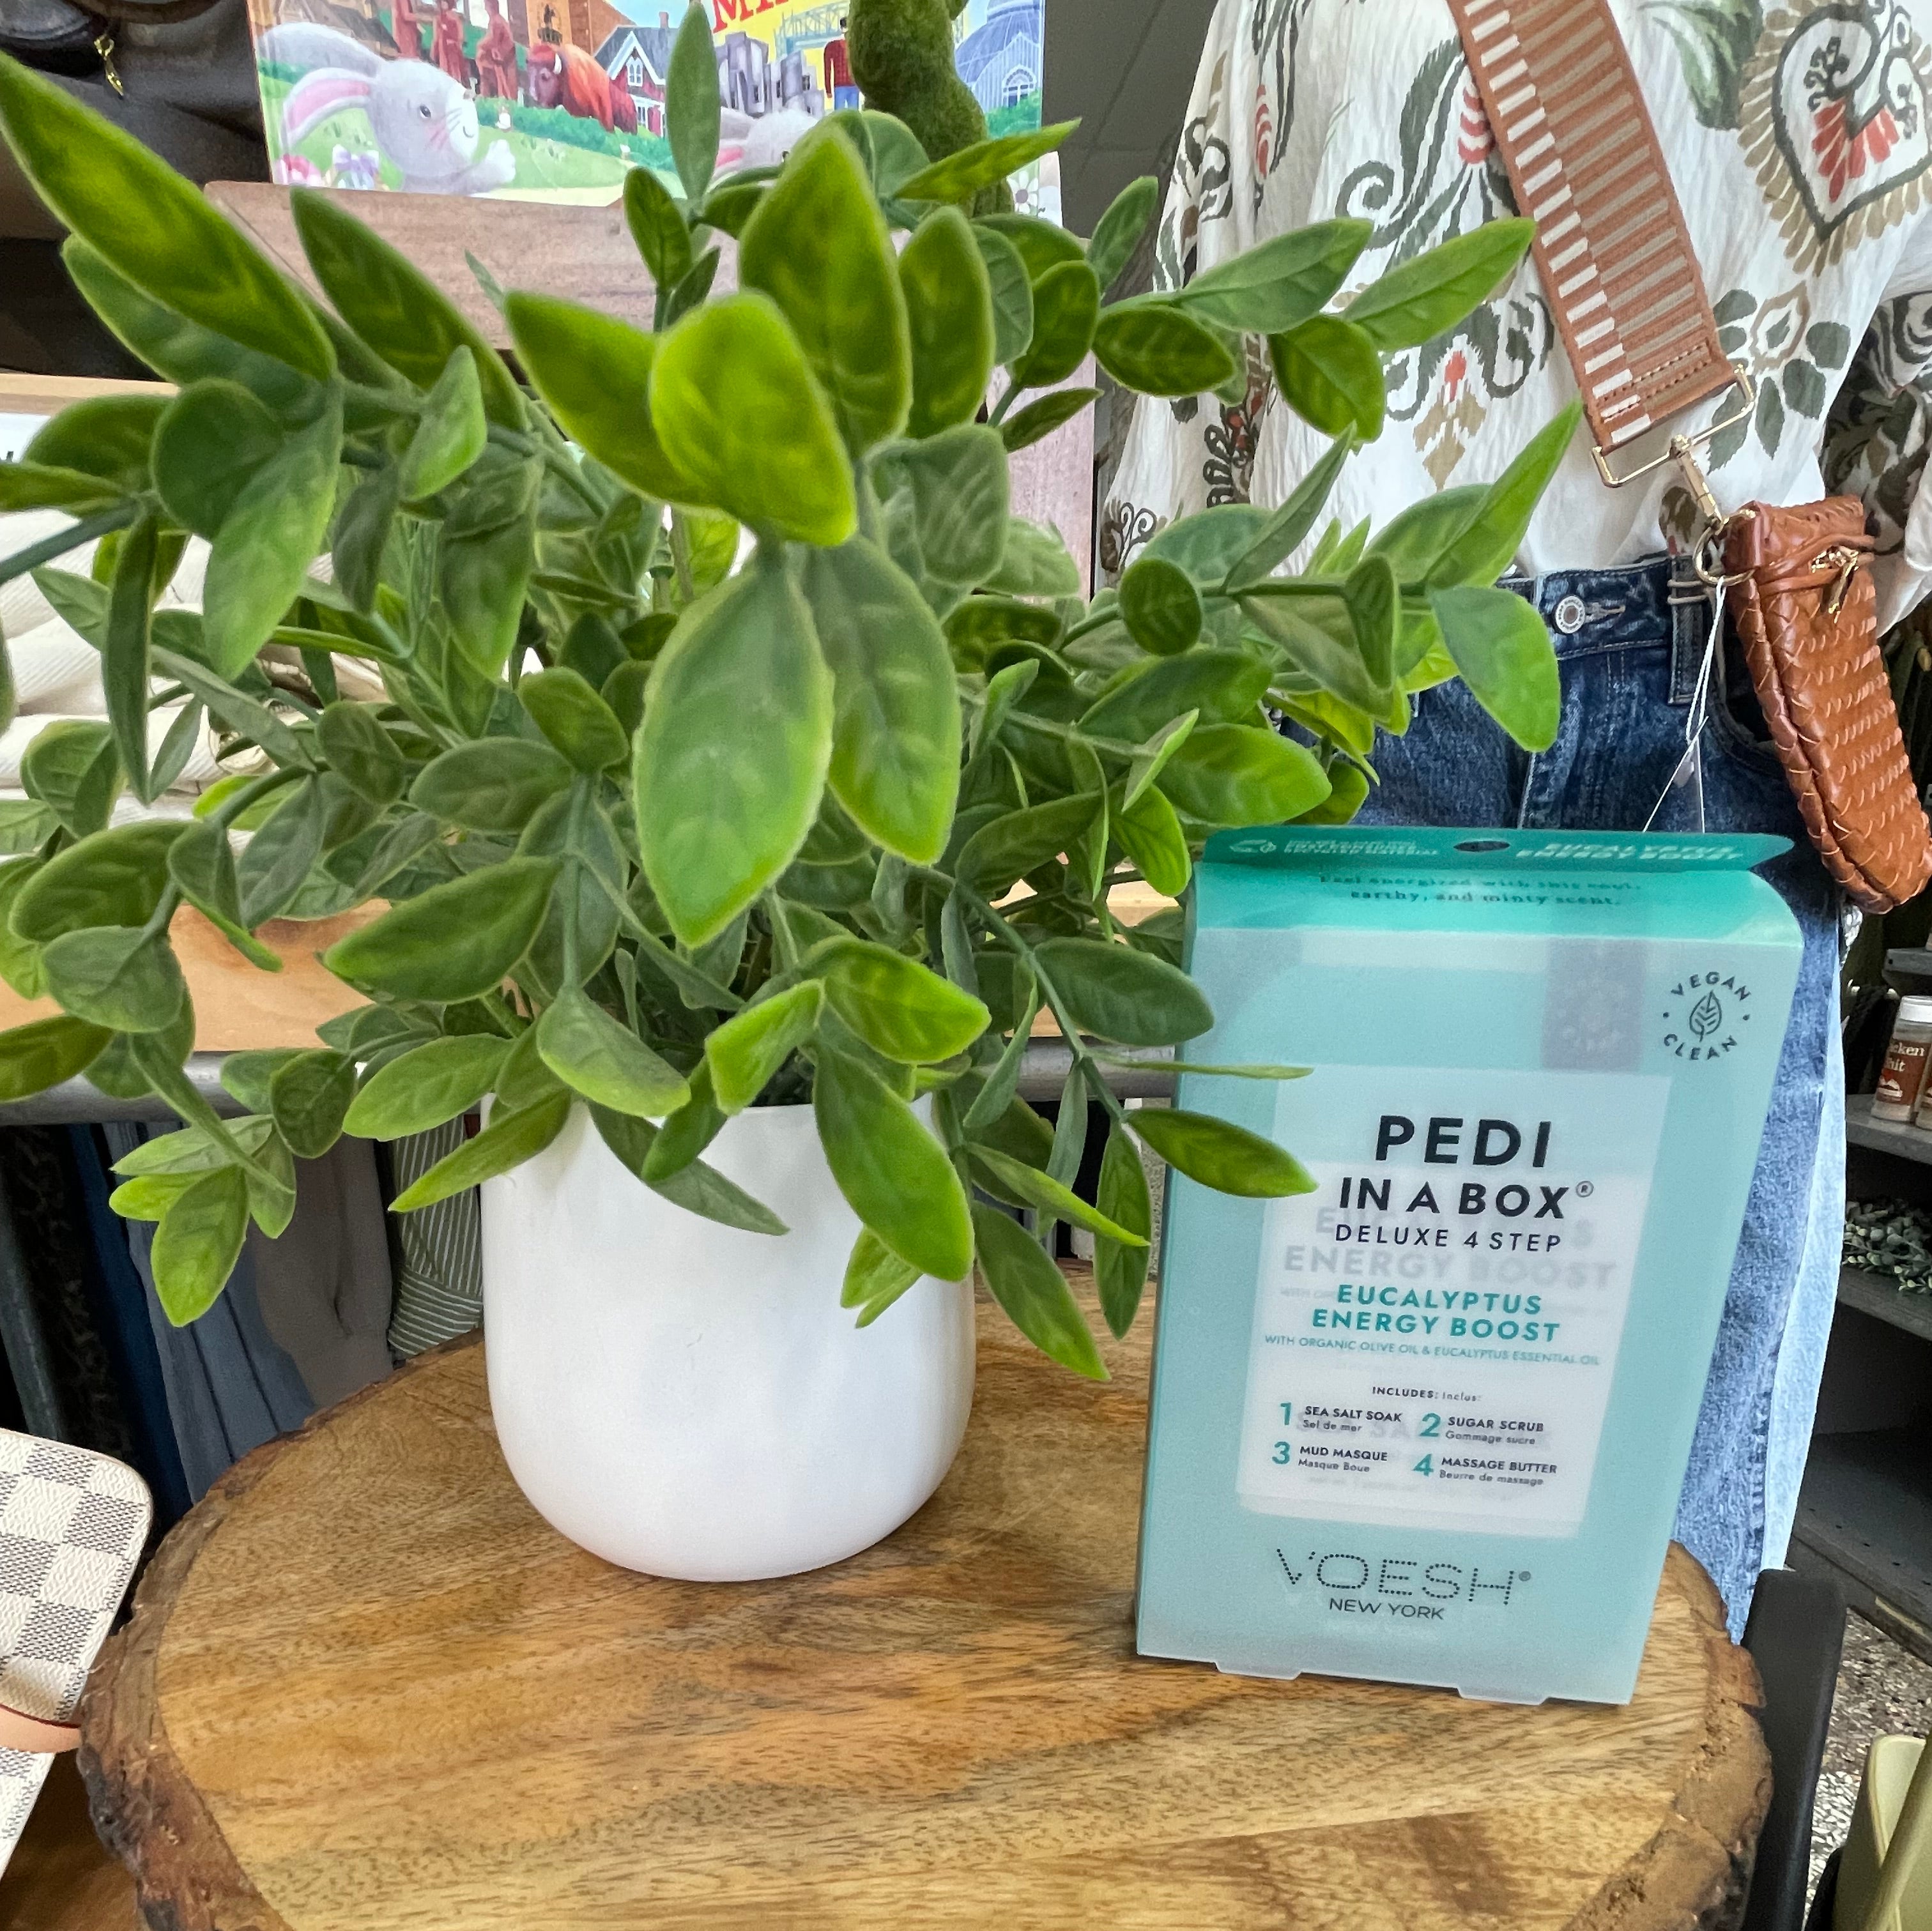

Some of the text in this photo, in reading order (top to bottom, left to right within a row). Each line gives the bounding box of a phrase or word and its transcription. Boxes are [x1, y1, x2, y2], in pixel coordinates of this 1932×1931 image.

[1436, 891, 1473, 902] and
[1482, 894, 1550, 905] minty
[1671, 972, 1751, 1001] VEGAN
[1664, 1034, 1737, 1060] CLEAN
[1375, 1115, 1551, 1168] PEDI
[1339, 1177, 1392, 1210] IN
[1406, 1181, 1440, 1213] A
[1335, 1224, 1449, 1248] DELUXE
[1463, 1230, 1480, 1249] 4
[1489, 1232, 1561, 1252] STEP
[1337, 1284, 1542, 1315] EUCALYPTUS
[1313, 1309, 1560, 1342] ENERGY BOOST
[1264, 1334, 1600, 1366] WITH ORGANIC OLIVE OIL & EUCALYPTUS ESSENTIAL OIL
[1372, 1385, 1439, 1400] INCLUDES:
[1280, 1402, 1404, 1426] 1 SEA SALT SOAK
[1303, 1419, 1320, 1429] Sel
[1323, 1421, 1337, 1430] de
[1419, 1412, 1544, 1437] 2 SUGAR SCRUB
[1445, 1430, 1503, 1444] Gommage
[1271, 1441, 1388, 1465] 3 MUD MASQUE
[1413, 1453, 1558, 1477] 4 MASSAGE BUTTER
[1298, 1458, 1370, 1473] Masque Boue
[1439, 1469, 1544, 1488] Beurre de massage
[1329, 1598, 1445, 1620] NEW YORK
